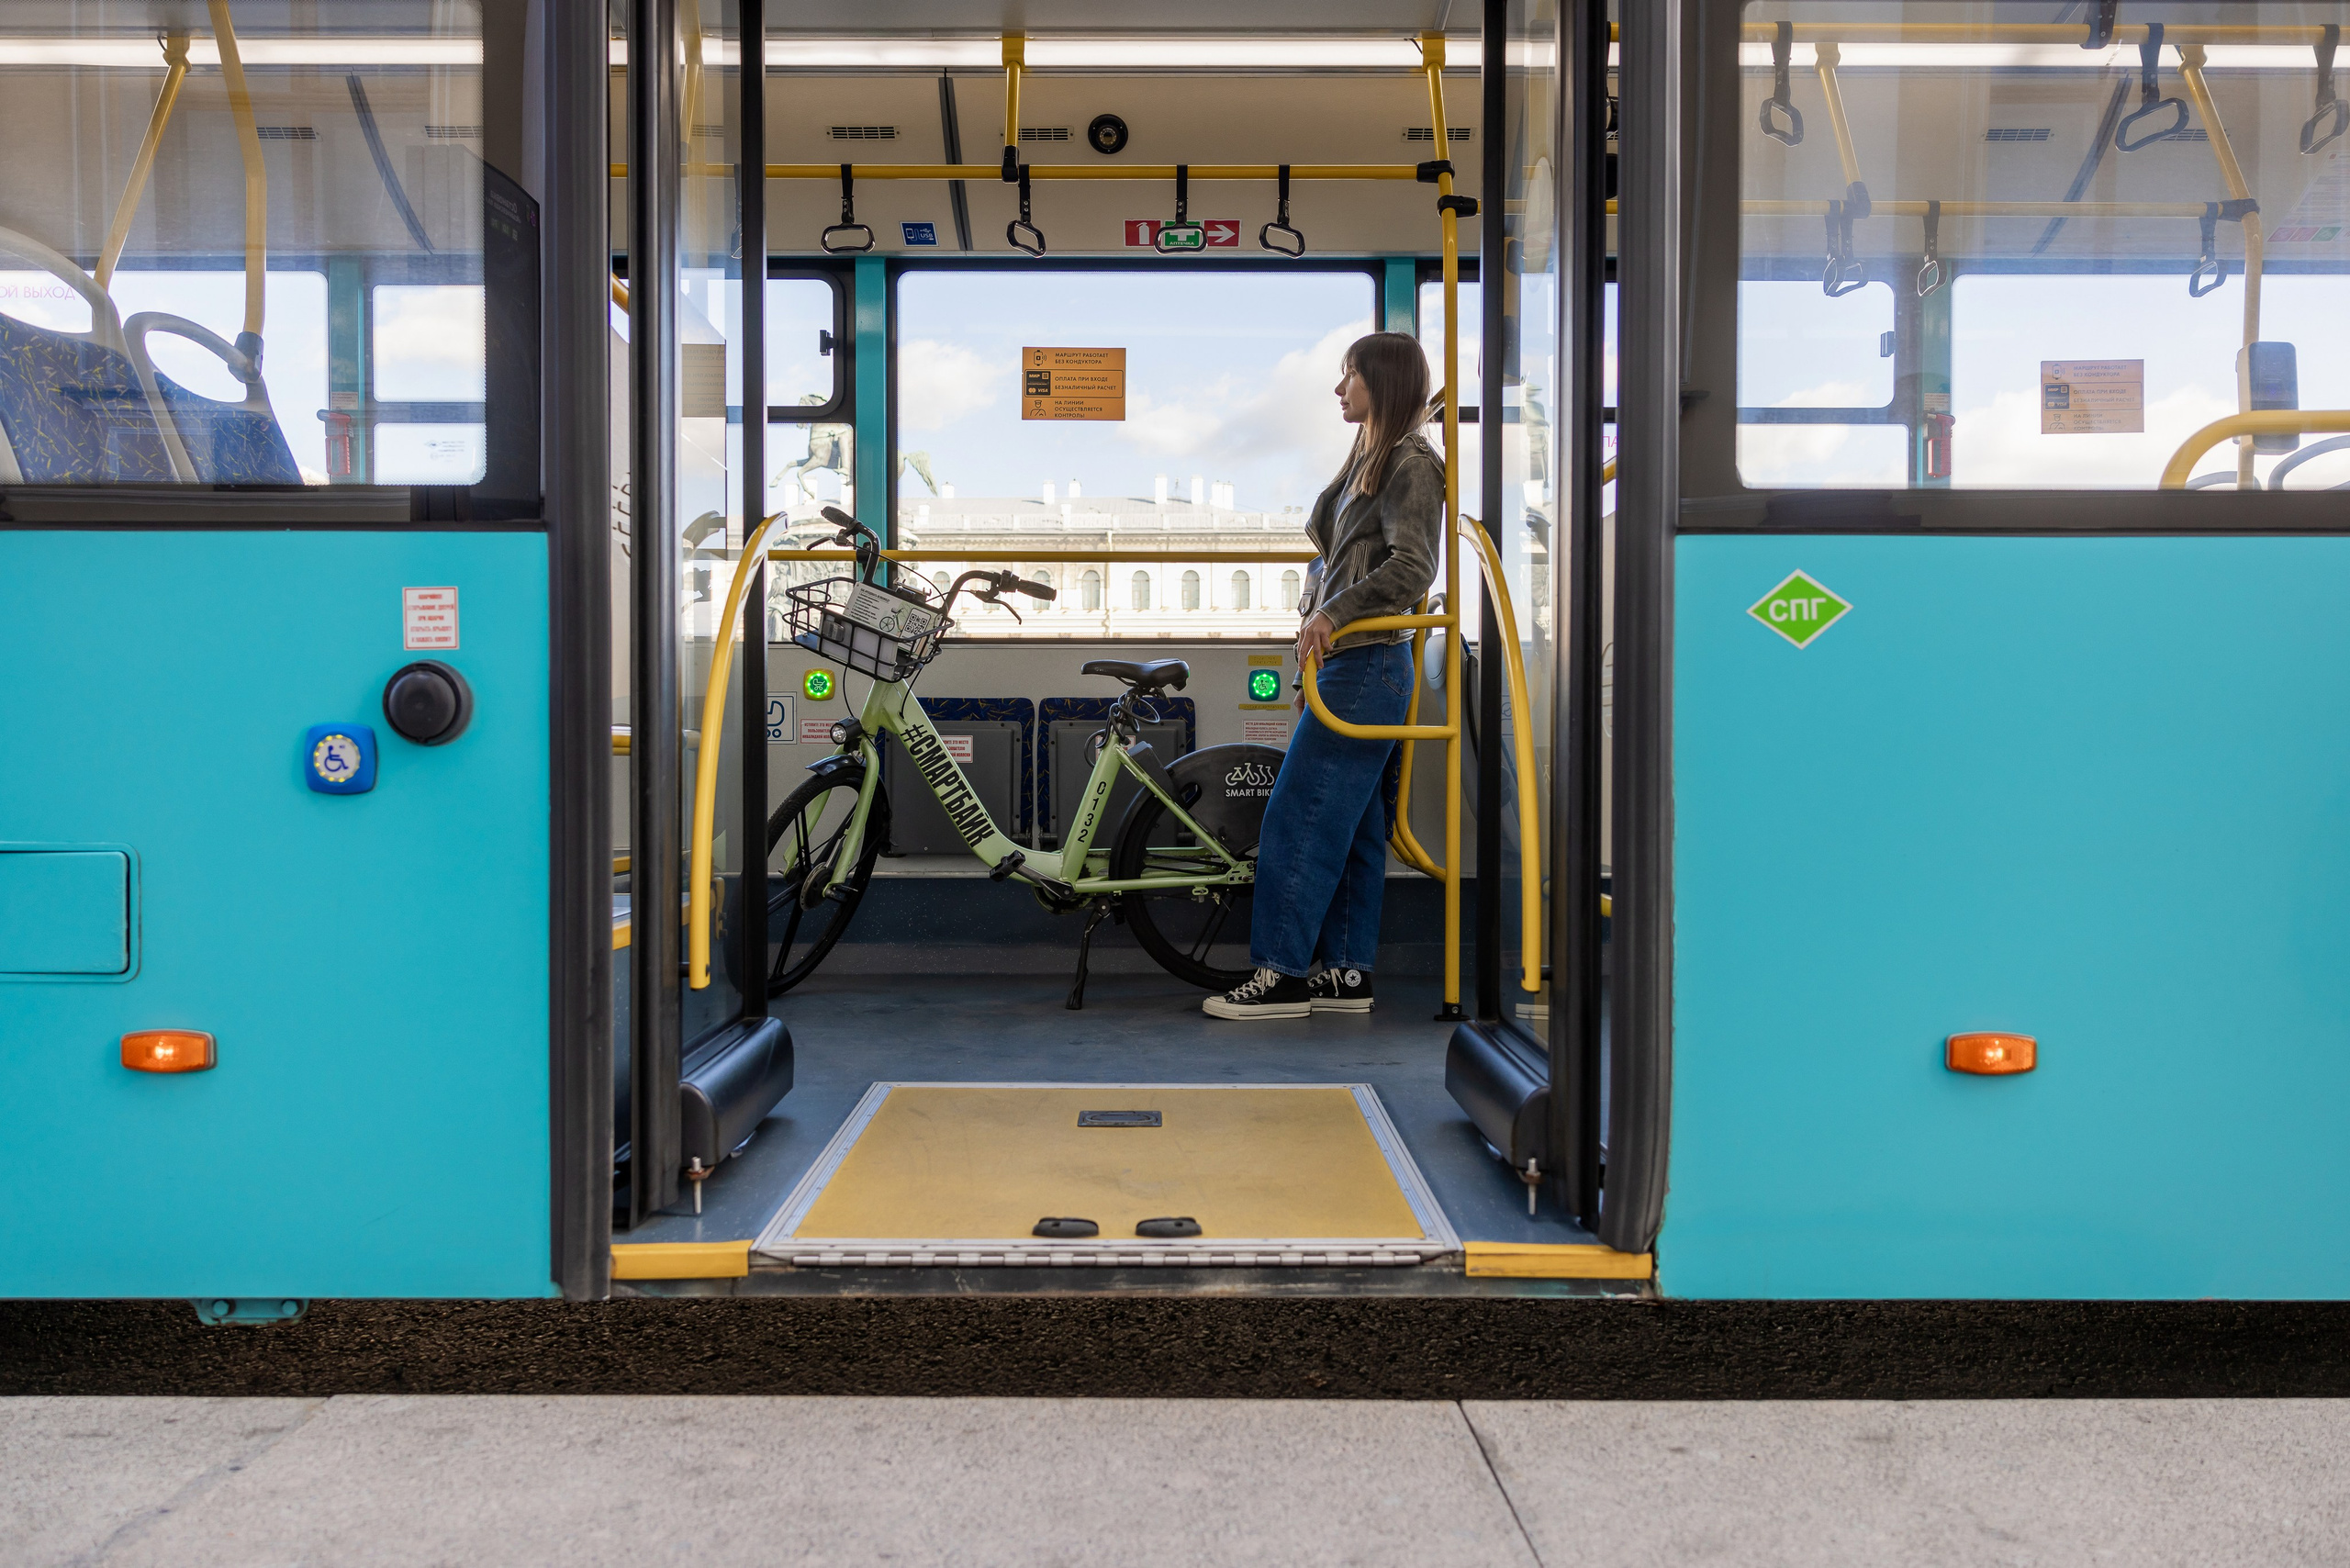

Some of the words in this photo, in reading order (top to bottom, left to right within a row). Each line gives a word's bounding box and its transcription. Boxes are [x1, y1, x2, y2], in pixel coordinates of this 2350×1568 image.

[24, 286, 76, 300] ВЫХОД
[1769, 598, 1827, 622] СПГ
[900, 723, 996, 849] #СМАРТБАЙК
[1225, 789, 1255, 797] SMART
[1077, 780, 1107, 844] 0132
